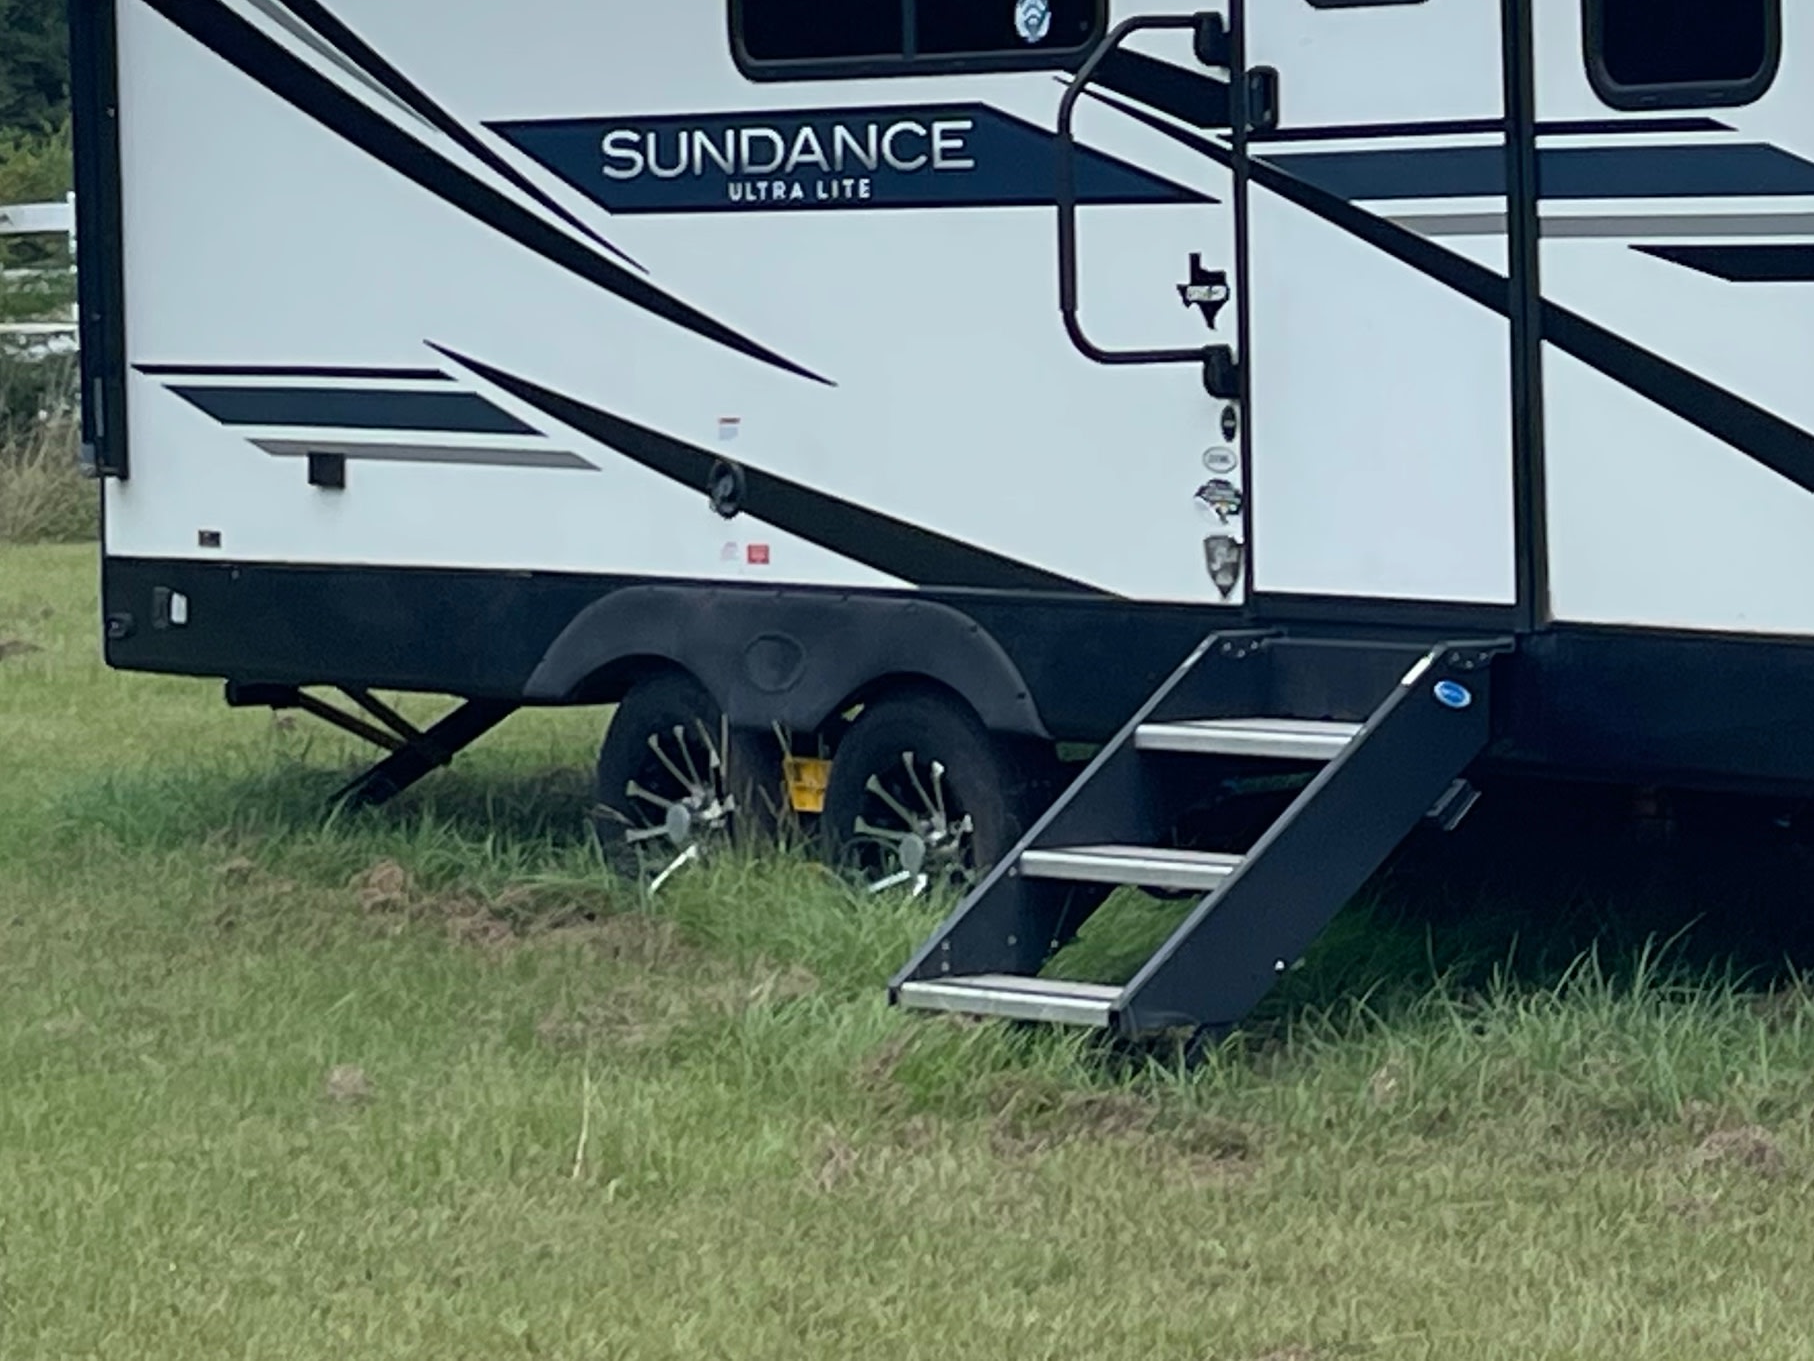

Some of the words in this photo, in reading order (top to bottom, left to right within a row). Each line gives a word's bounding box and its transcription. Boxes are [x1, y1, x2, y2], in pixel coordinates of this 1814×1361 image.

[601, 120, 975, 179] SUNDANCE
[728, 180, 804, 201] ULTRA
[816, 178, 871, 199] LITE
